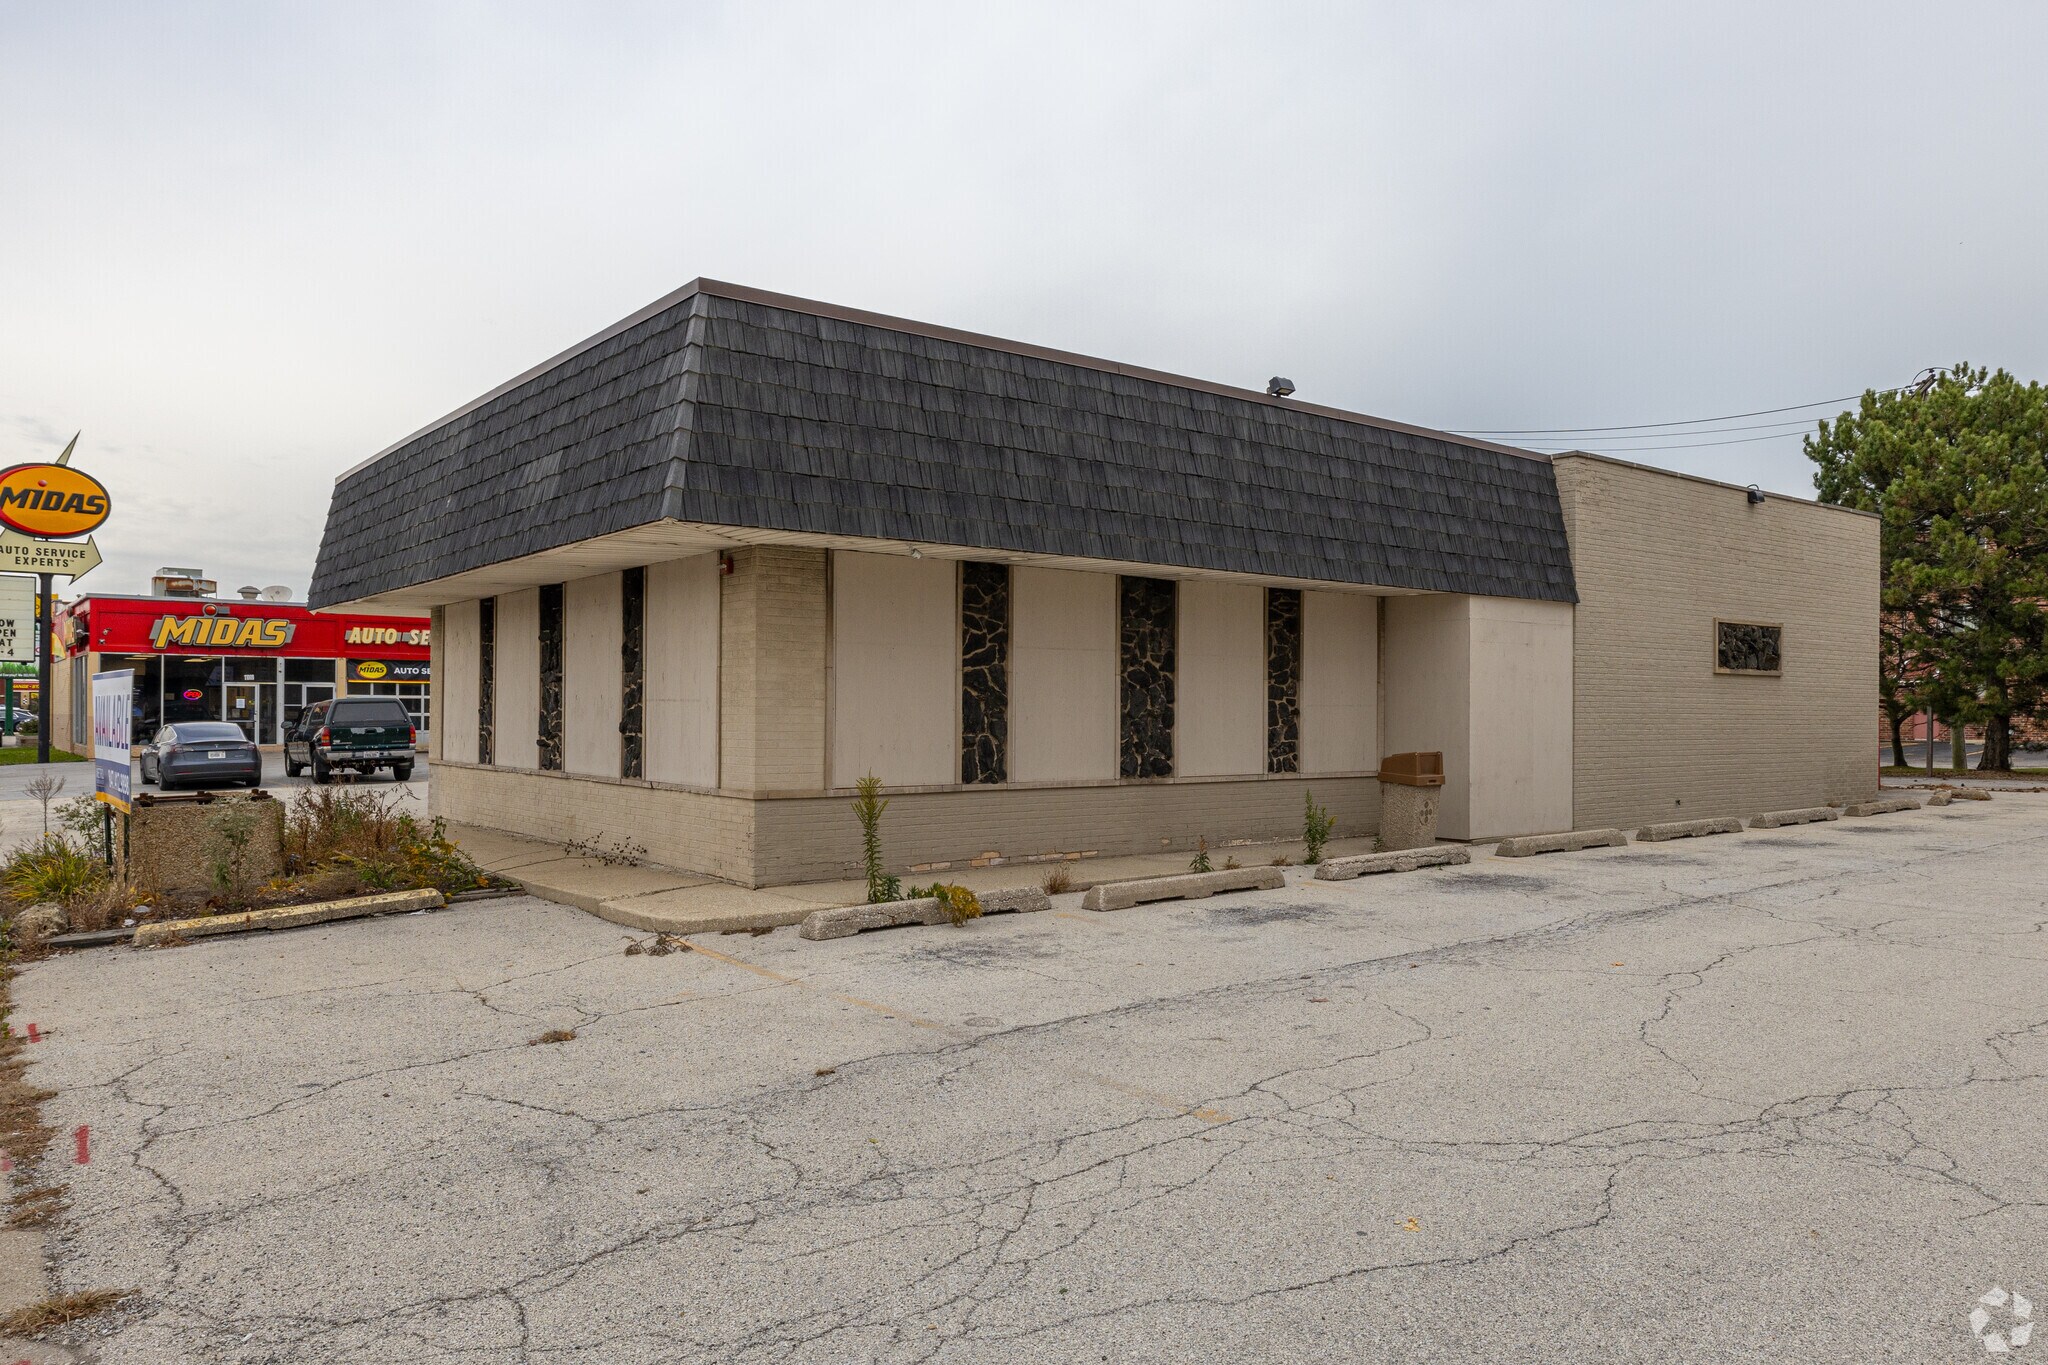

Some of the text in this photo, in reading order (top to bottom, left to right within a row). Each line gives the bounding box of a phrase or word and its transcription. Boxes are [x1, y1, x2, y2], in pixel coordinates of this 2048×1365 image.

[0, 480, 105, 514] MIDAS
[36, 547, 86, 559] SERVICE
[154, 604, 289, 648] MIDAS
[347, 627, 398, 645] AUTO
[359, 664, 385, 674] MIDAS
[394, 667, 419, 675] AUTO
[95, 694, 130, 750] AVAILABLE
